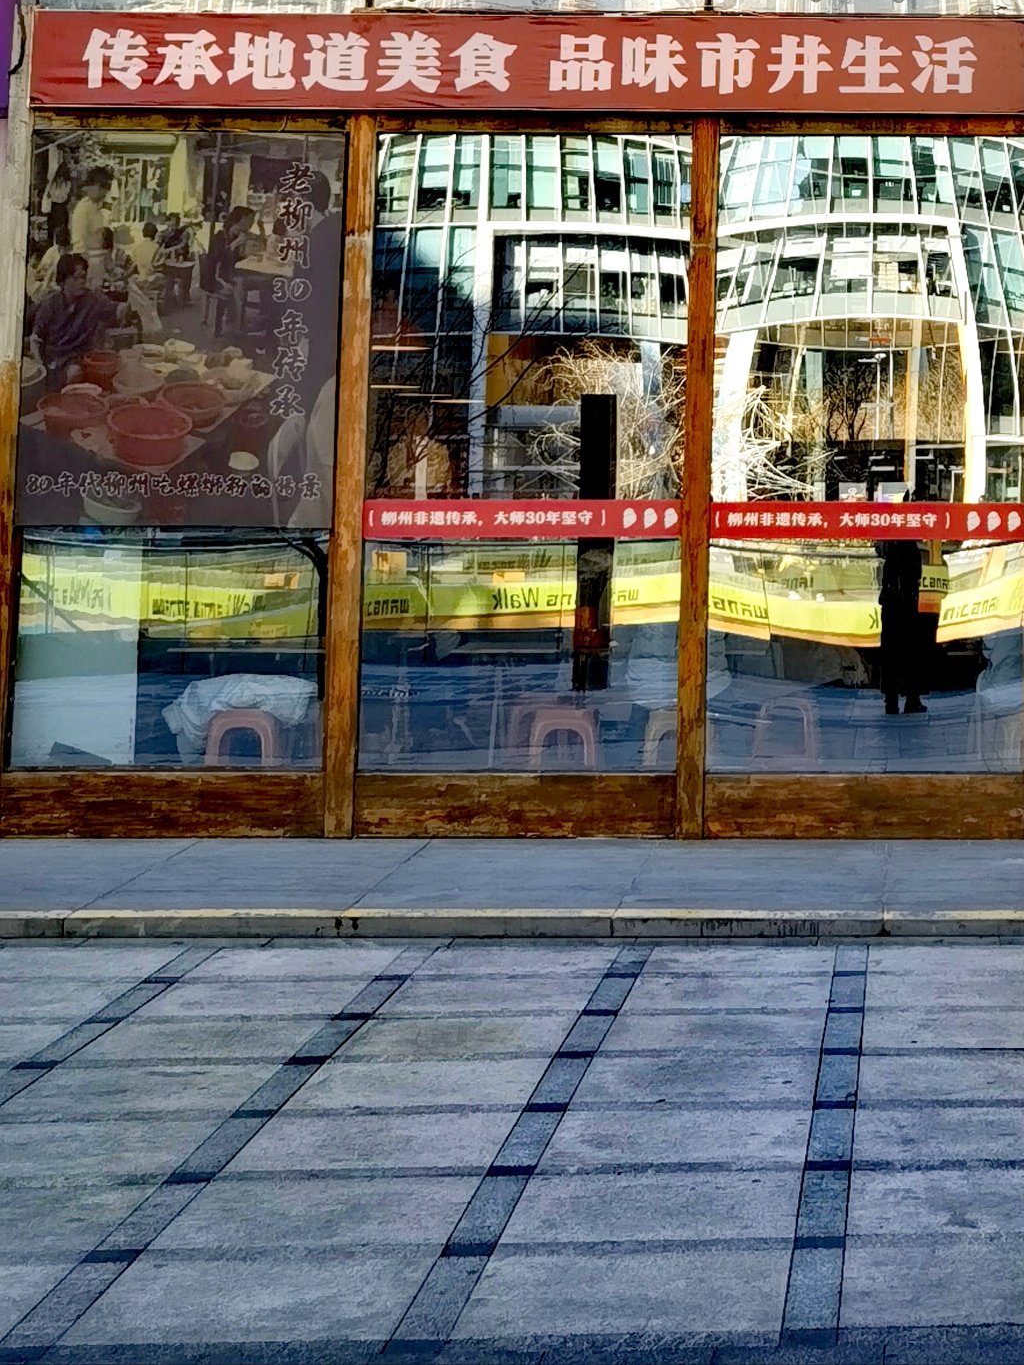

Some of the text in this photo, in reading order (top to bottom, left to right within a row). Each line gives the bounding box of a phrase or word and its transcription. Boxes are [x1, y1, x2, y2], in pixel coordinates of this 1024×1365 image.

[82, 28, 978, 95] 传承地道美食 品味市井生活
